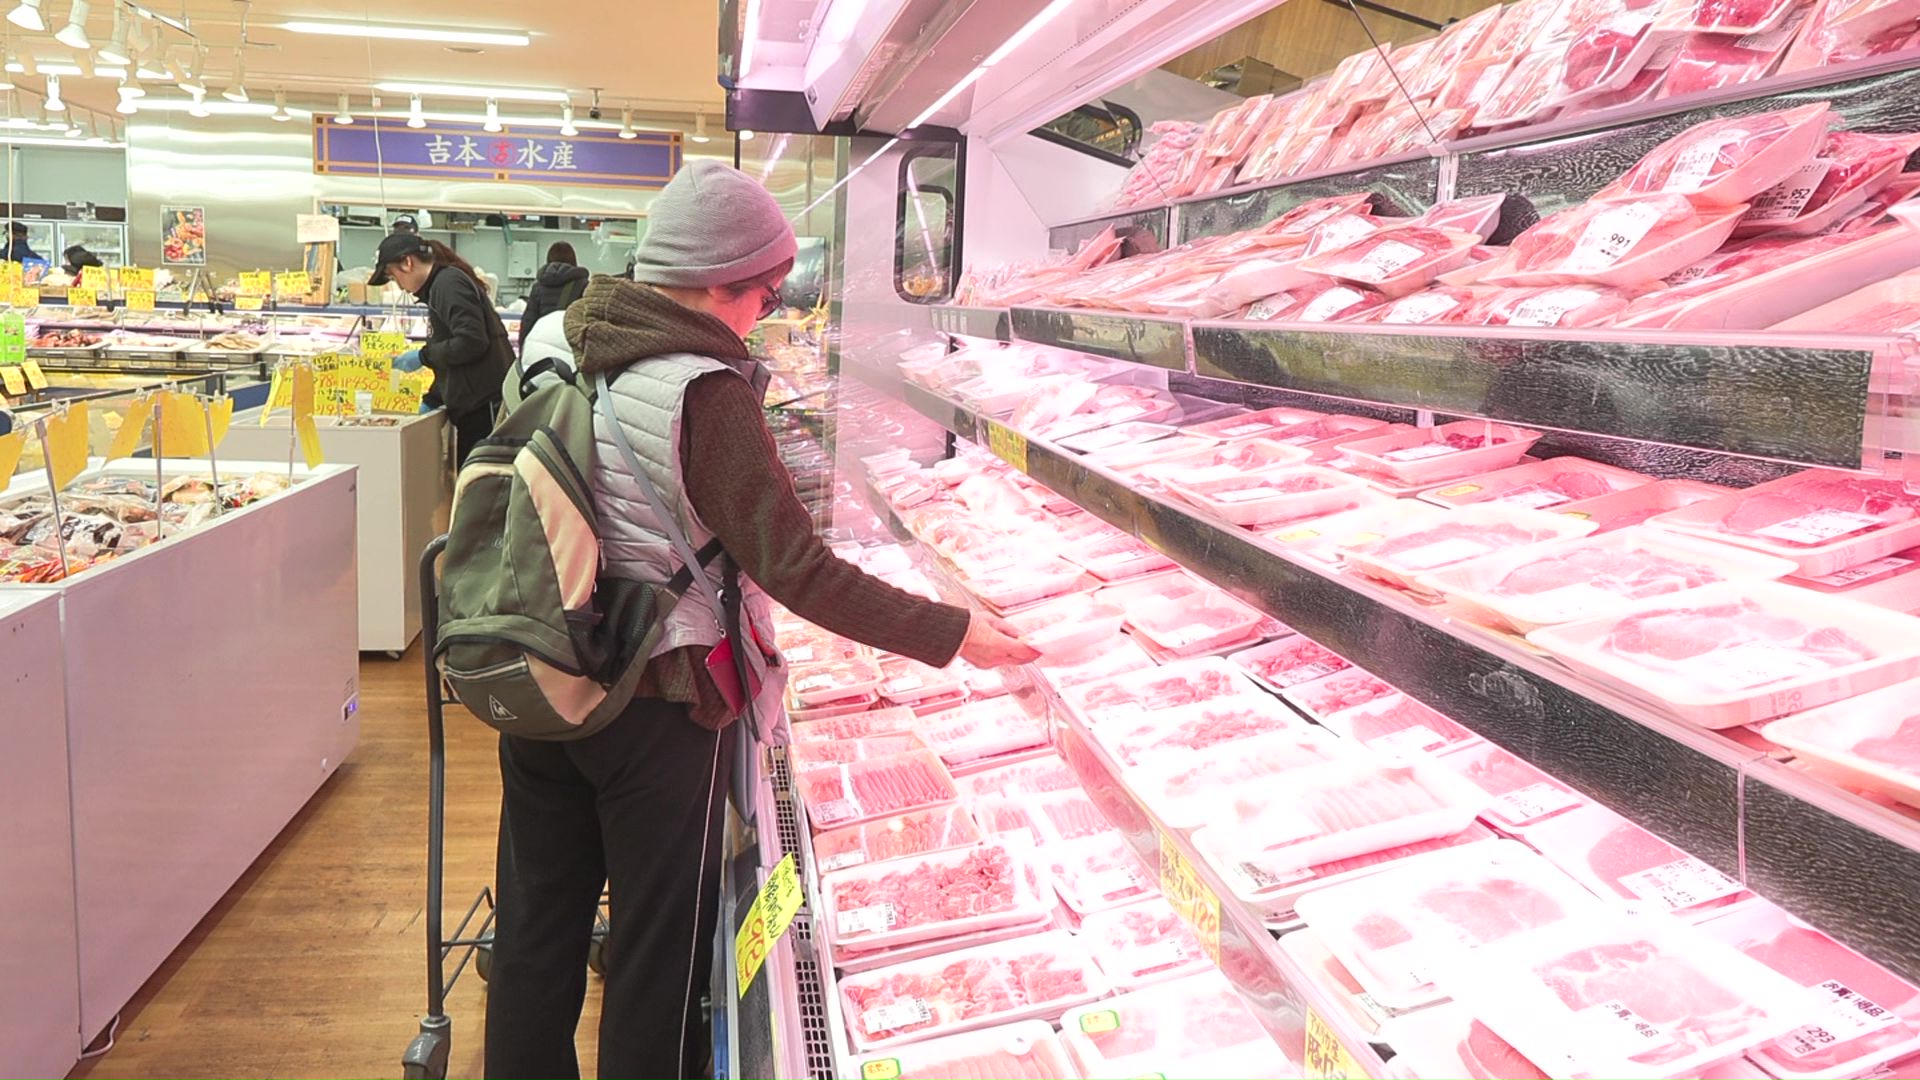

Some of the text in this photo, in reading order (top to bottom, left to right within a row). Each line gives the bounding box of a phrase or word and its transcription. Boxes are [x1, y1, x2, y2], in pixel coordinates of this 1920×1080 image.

[425, 134, 486, 167] 吉本
[516, 139, 577, 170] 水産
[1791, 188, 1811, 199] 952
[1609, 233, 1631, 248] 991
[1807, 1026, 1836, 1043] 293
